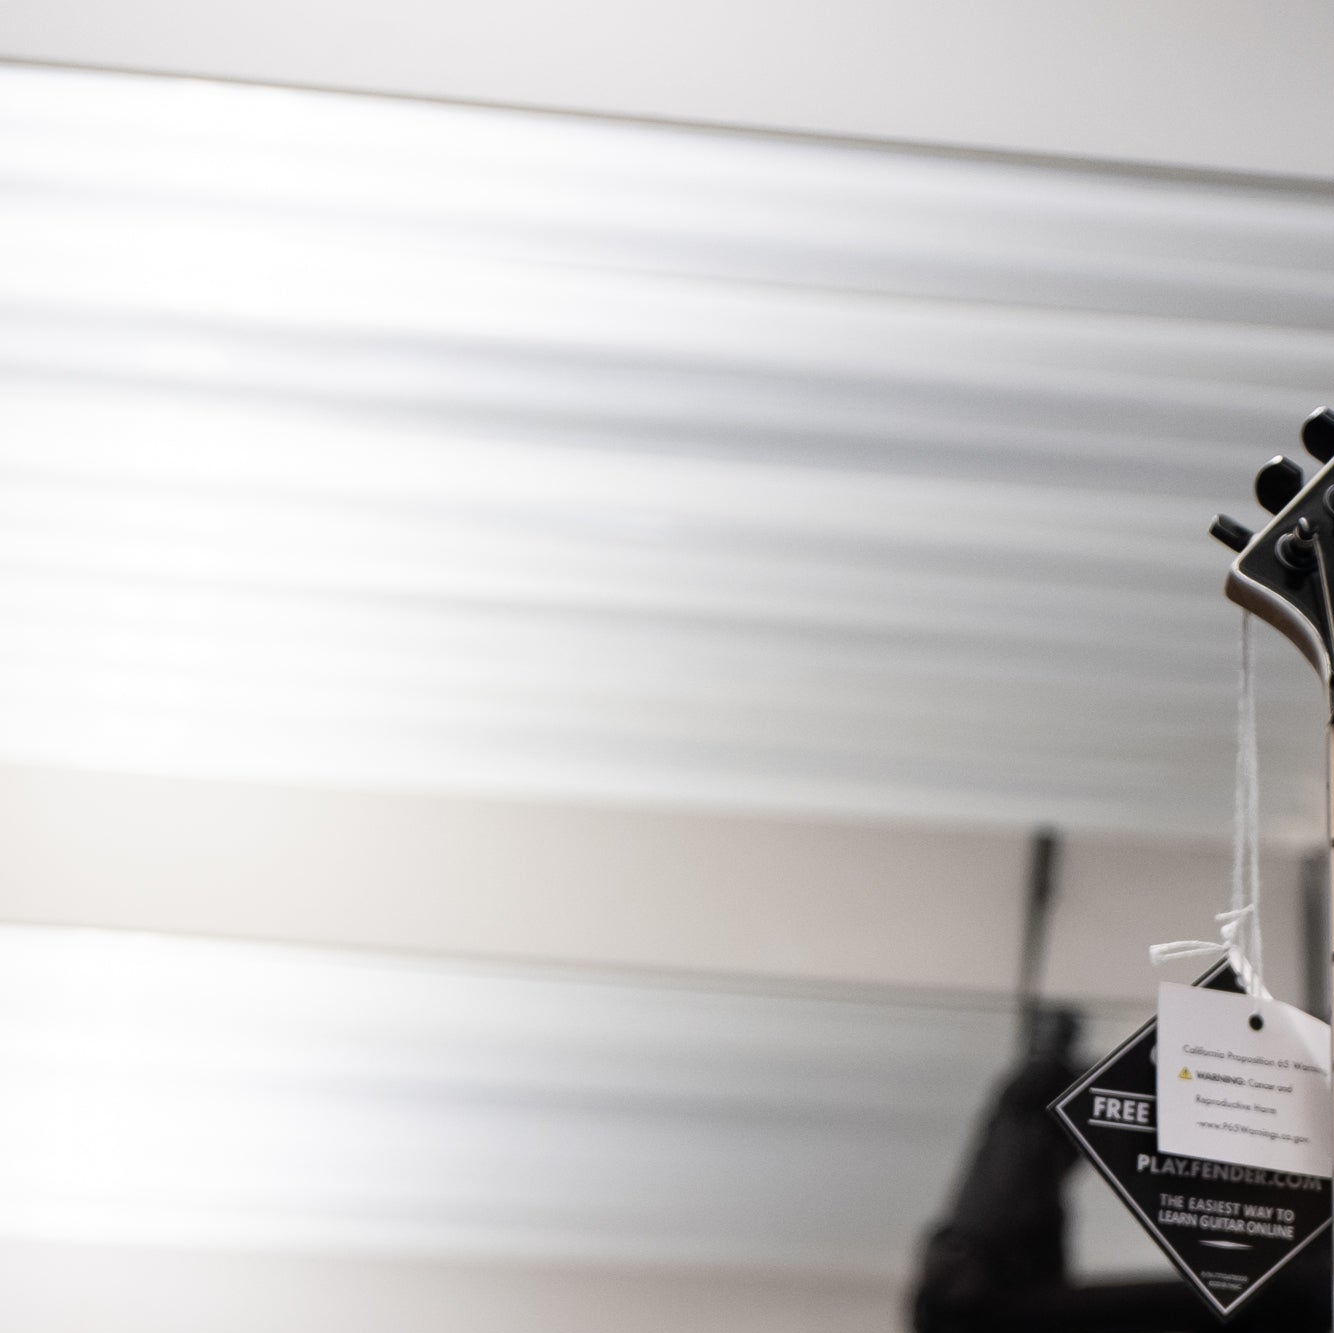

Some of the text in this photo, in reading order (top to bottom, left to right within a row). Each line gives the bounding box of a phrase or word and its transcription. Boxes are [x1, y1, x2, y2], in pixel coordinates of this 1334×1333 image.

[1182, 1044, 1225, 1059] California
[1227, 1051, 1275, 1066] Proposition
[1277, 1059, 1289, 1068] 65
[1196, 1070, 1293, 1093] WARNING: Cancer and
[1093, 1096, 1150, 1123] FREE
[1196, 1093, 1277, 1115] Reproductive Harm
[1137, 1153, 1322, 1191] PLAY.FENDER.COM
[1159, 1193, 1295, 1221] THE EASIEST WAY TO
[1158, 1210, 1294, 1239] LEARN GUITAR ONLINE
